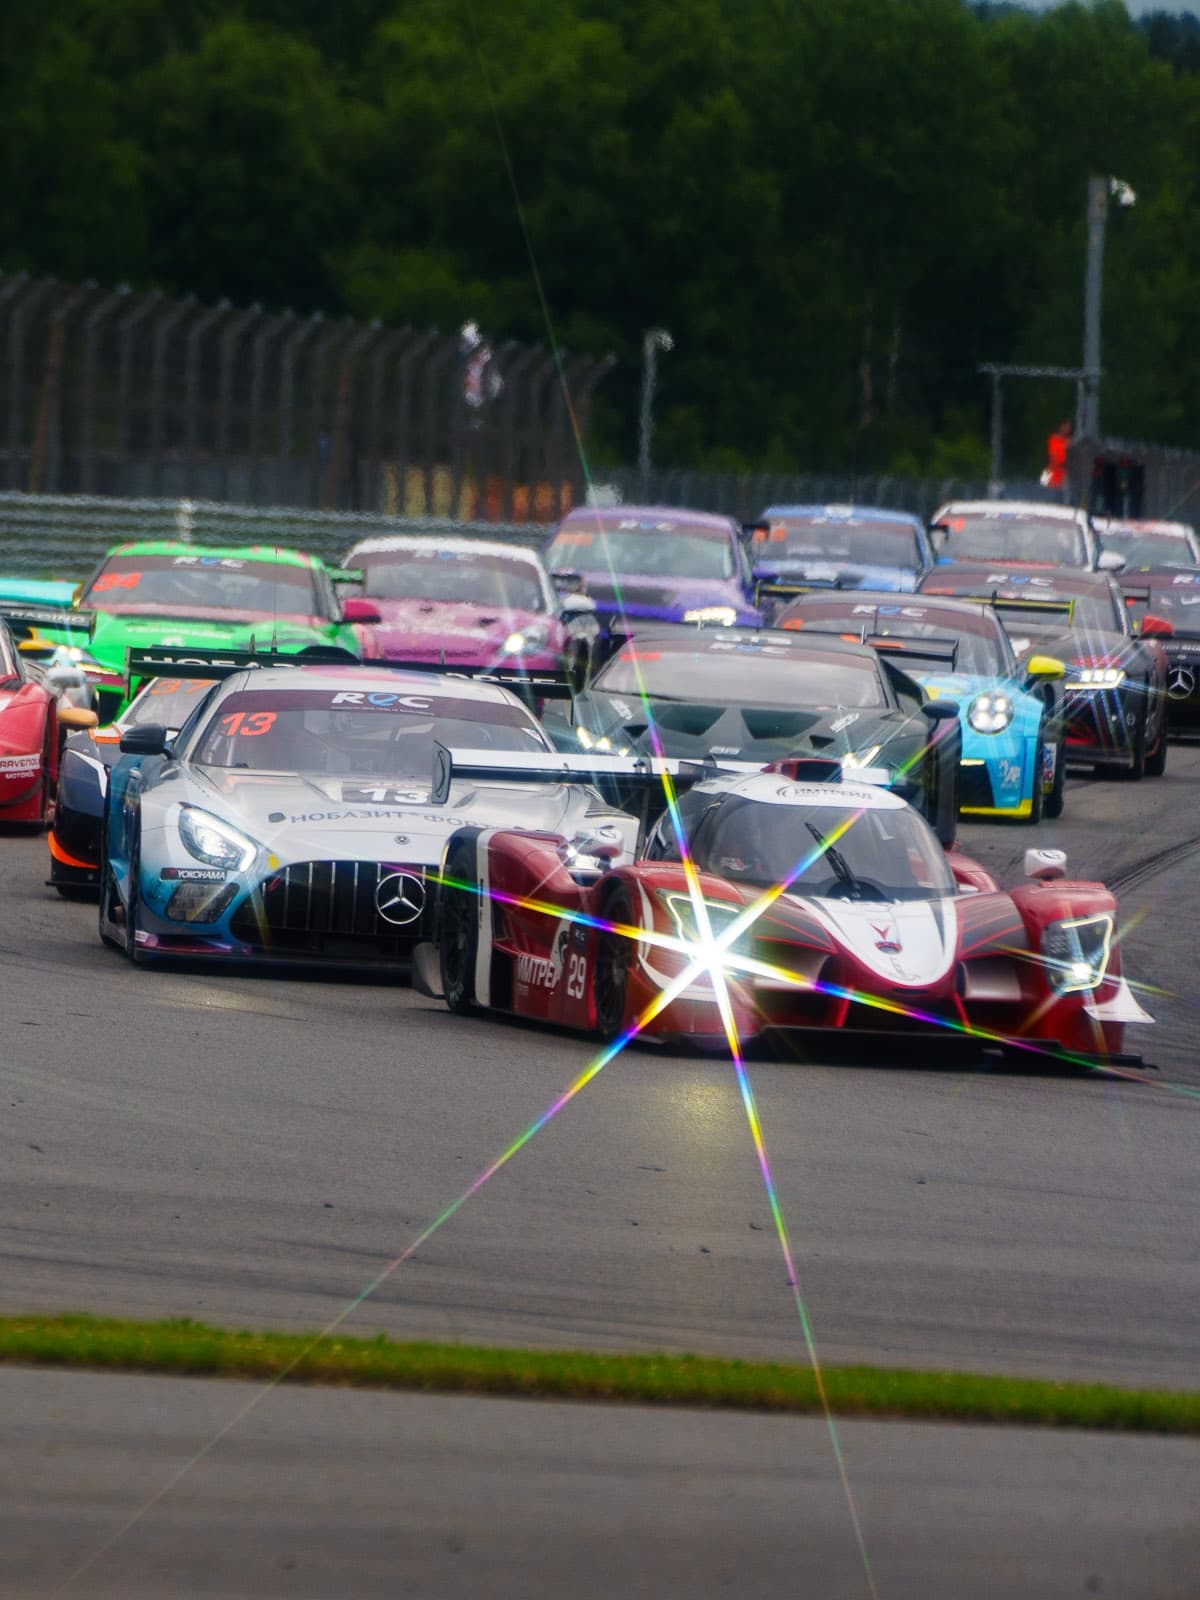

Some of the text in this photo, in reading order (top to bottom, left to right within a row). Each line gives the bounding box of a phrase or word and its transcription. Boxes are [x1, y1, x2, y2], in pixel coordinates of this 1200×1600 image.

[222, 711, 278, 737] 13
[359, 788, 429, 804] 13
[177, 870, 226, 880] YOKOHAMA
[567, 953, 587, 999] 29
